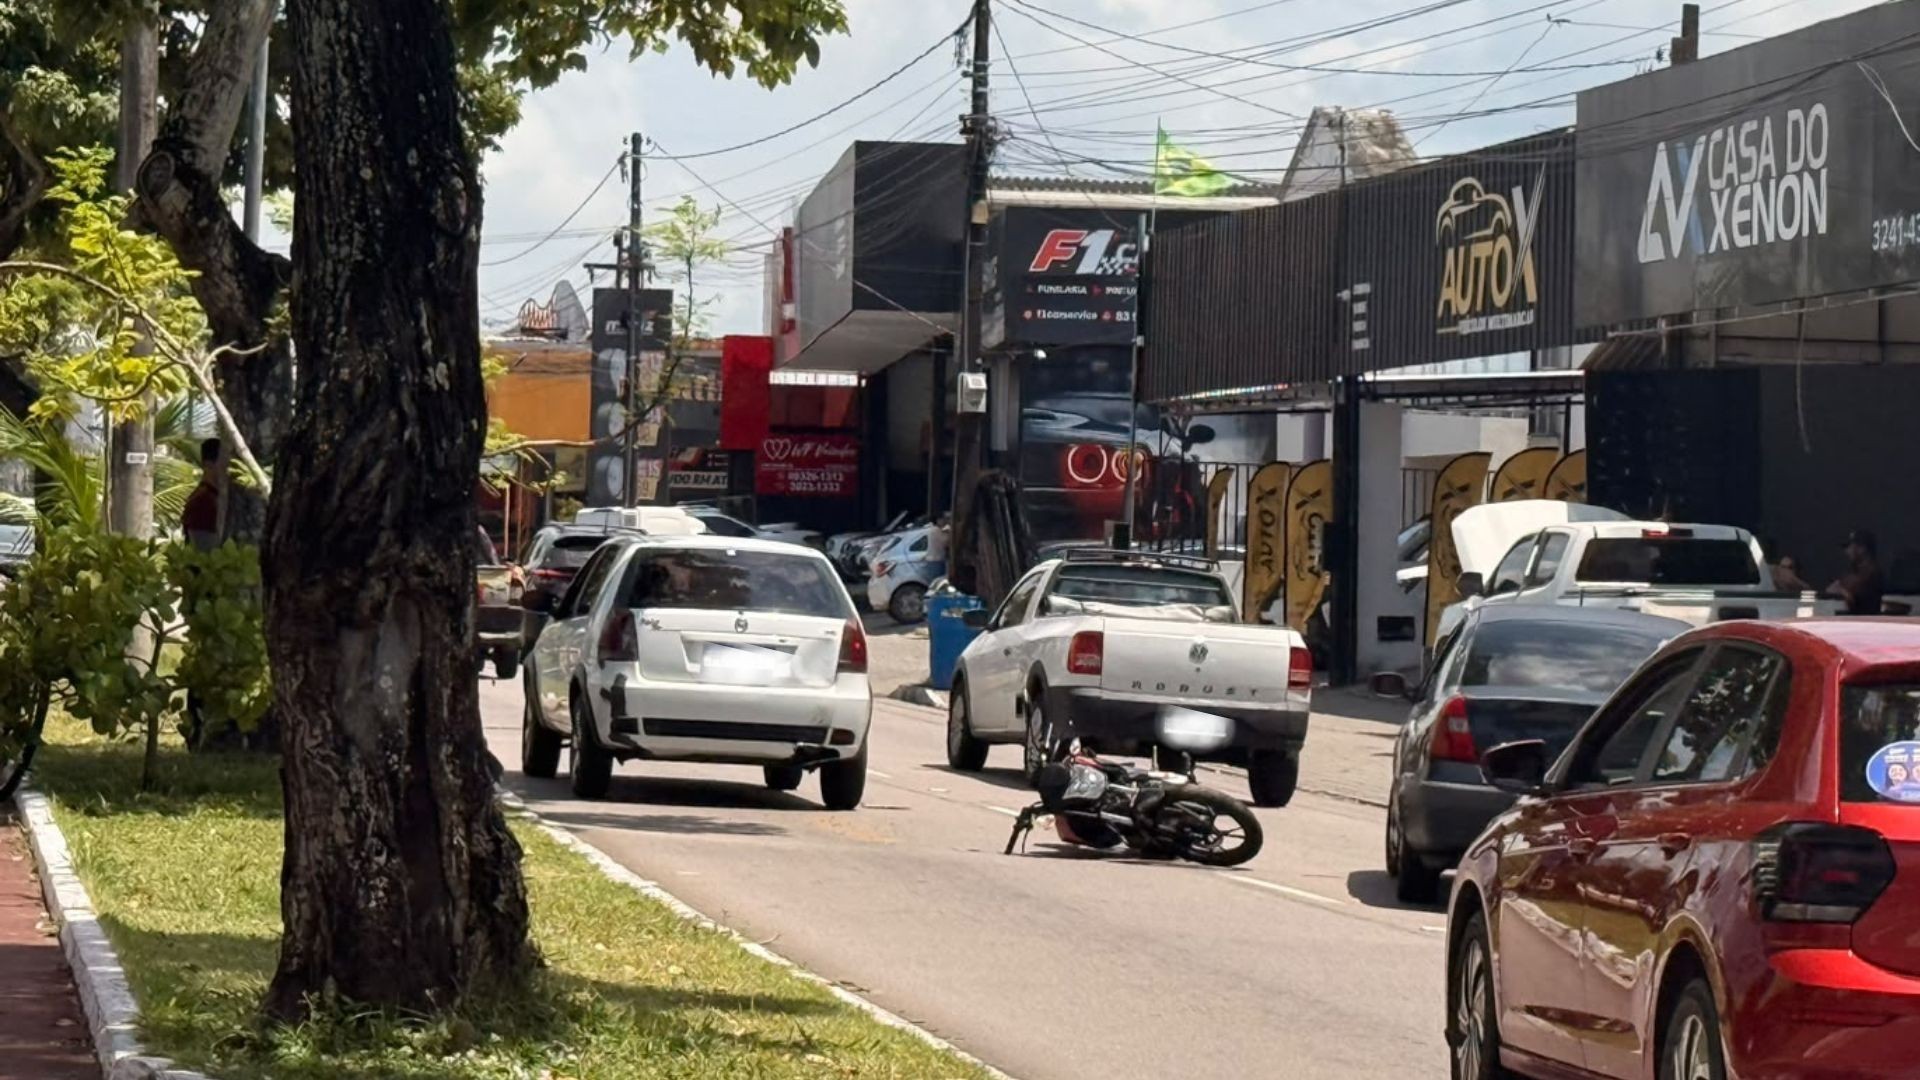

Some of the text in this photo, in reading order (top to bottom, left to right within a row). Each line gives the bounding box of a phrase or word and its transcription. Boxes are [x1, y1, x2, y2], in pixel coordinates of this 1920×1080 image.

[1708, 103, 1829, 190] CASA DO
[1708, 168, 1828, 254] XENON
[1029, 229, 1115, 275] F1
[1115, 312, 1130, 322] 83
[1131, 680, 1258, 696] ROBUST
